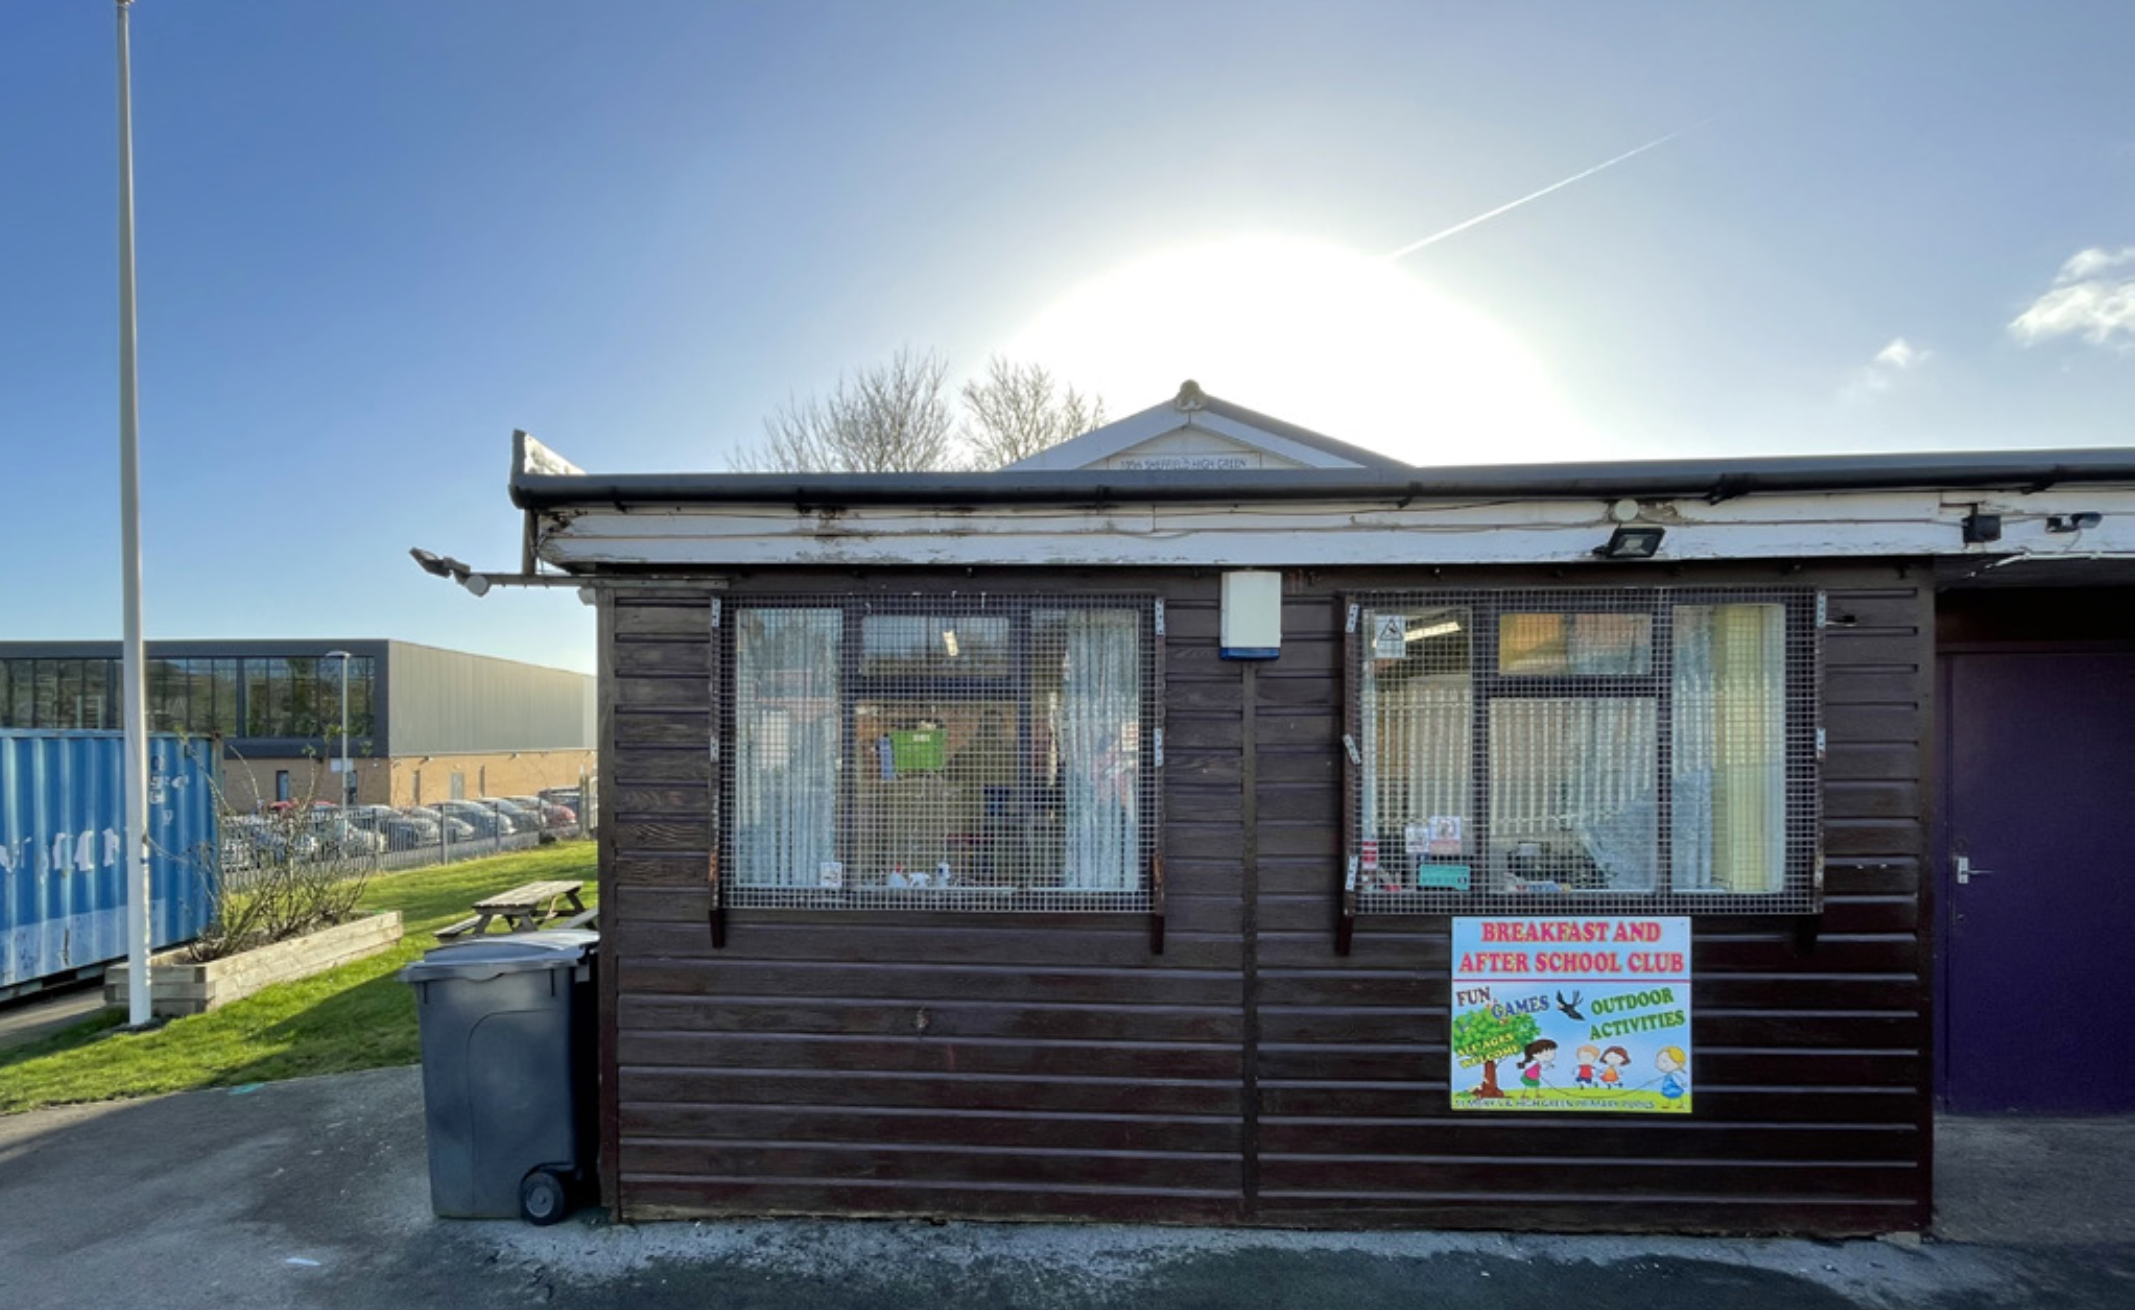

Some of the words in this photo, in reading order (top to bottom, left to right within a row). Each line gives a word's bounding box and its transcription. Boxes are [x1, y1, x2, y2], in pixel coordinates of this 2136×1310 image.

[1217, 458, 1246, 470] GREEN
[1482, 921, 1609, 942] BREAKFAST
[1613, 921, 1661, 942] AND
[1459, 953, 1529, 973] AFTER
[1535, 952, 1621, 973] SCHOOL
[1627, 953, 1684, 973] CLUB
[1491, 995, 1550, 1019] GAMES
[1590, 987, 1674, 1015] OUTDOOR
[1590, 1010, 1685, 1041] ACTIVITIES
[1457, 1043, 1479, 1058] ALL
[1482, 1033, 1514, 1050] AGES
[1516, 1100, 1540, 1108] HIGH
[1541, 1100, 1573, 1108] GREEN
